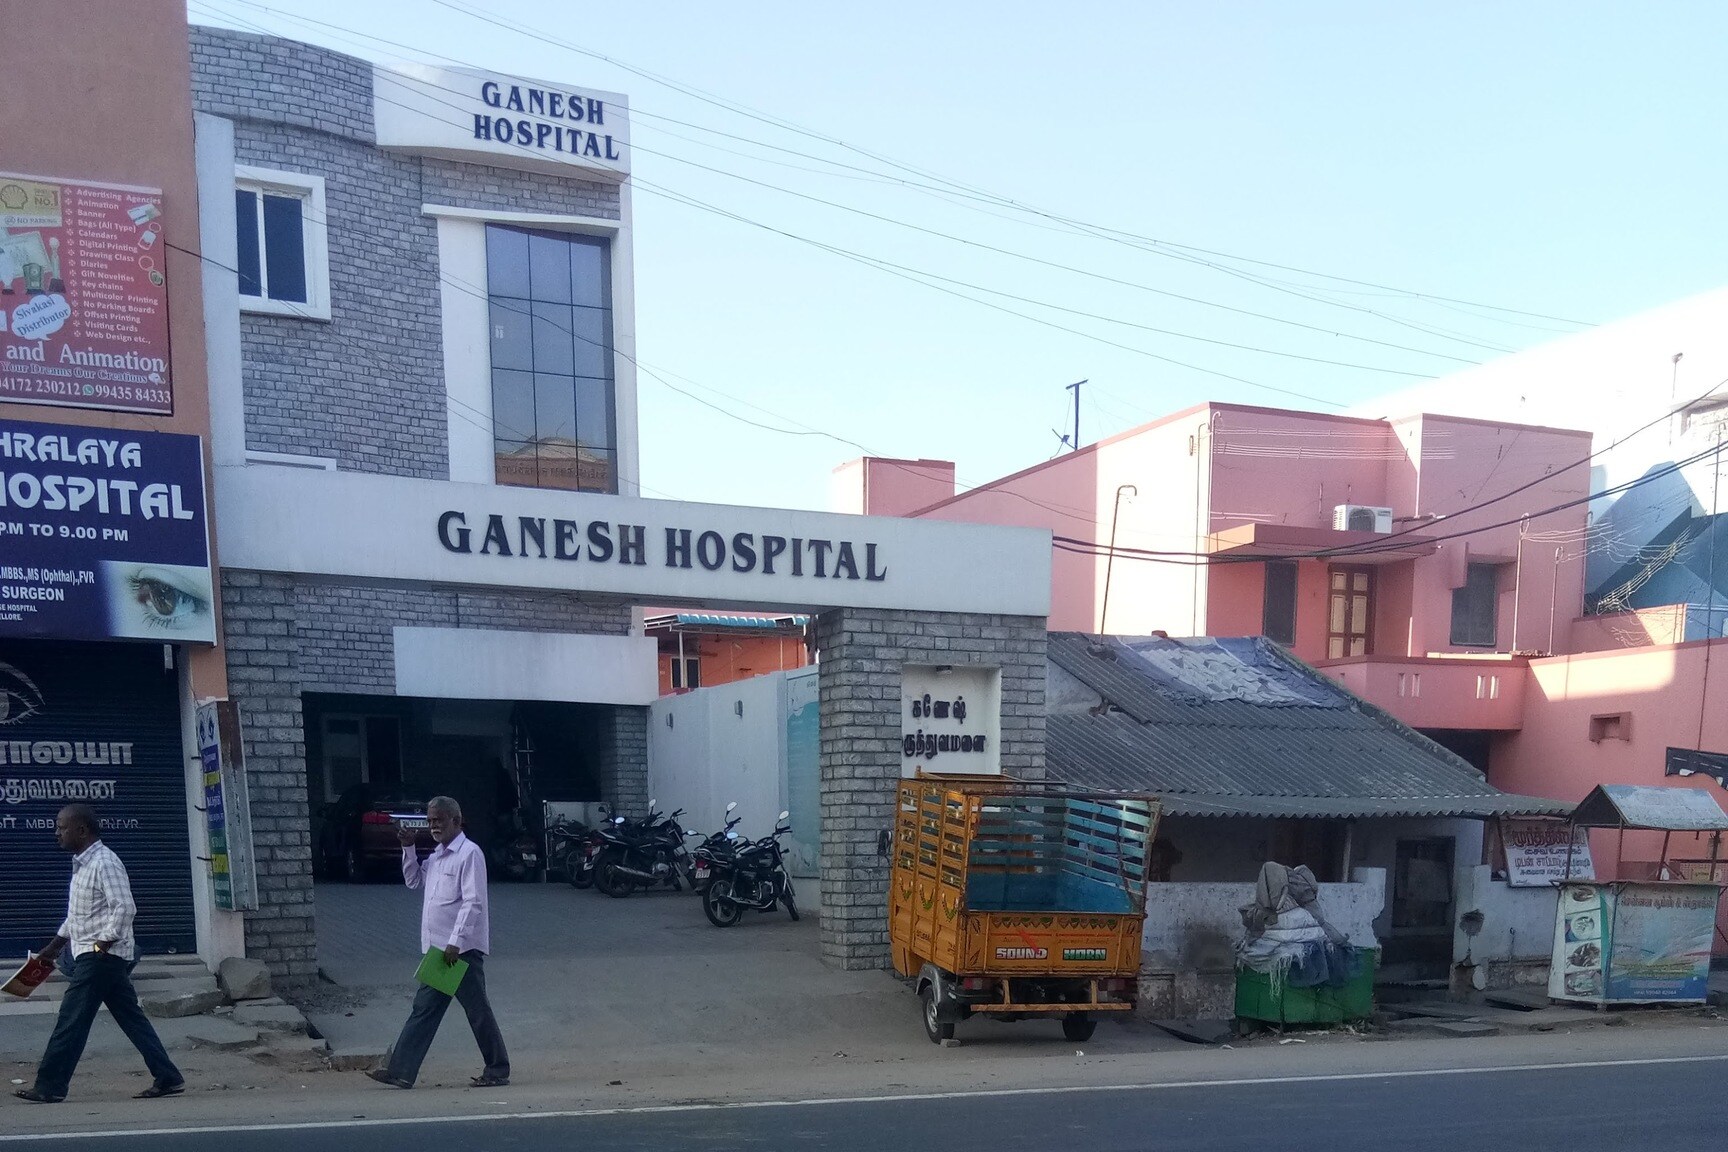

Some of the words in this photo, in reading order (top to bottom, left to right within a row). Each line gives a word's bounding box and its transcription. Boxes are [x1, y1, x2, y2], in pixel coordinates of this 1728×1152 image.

[481, 81, 604, 125] GANESH
[473, 114, 620, 160] HOSPITAL
[77, 189, 122, 201] Advertising
[126, 195, 161, 204] Agencies
[78, 200, 119, 210] Animation
[78, 209, 106, 218] Banner
[78, 220, 97, 228] Bags
[98, 221, 112, 230] (All
[115, 223, 136, 233] Type)
[79, 230, 117, 240] Calendars
[79, 240, 105, 249] Digital
[107, 243, 138, 253] Printing
[80, 250, 113, 260] Drawing
[115, 254, 134, 262] Class
[80, 261, 108, 269] Diaries
[98, 272, 134, 282] Novelties
[82, 281, 96, 289] Key
[98, 282, 123, 291] chains
[82, 291, 124, 301] Multicolor
[128, 295, 158, 305] Printing
[16, 296, 56, 319] Sivakasi
[97, 302, 126, 312] Parking
[128, 306, 155, 314] Boards
[17, 307, 69, 336] Distributor
[84, 311, 108, 319] Offset
[110, 314, 141, 324] Printing
[85, 321, 114, 331] Visiting
[116, 324, 138, 332] Cards
[86, 331, 104, 339] Web
[106, 333, 132, 342] Design
[6, 341, 45, 361] and
[59, 343, 167, 372] Animation
[0, 361, 29, 374] Your
[30, 363, 72, 377] Dreams
[73, 367, 96, 379] Our
[98, 369, 147, 384] Creations
[0, 377, 32, 392] 4172
[36, 380, 81, 396] 230212
[95, 385, 132, 400] 99435
[135, 389, 171, 404] 84333
[29, 524, 54, 537] TO
[59, 525, 97, 540] 9.00
[102, 528, 129, 542] PM
[437, 510, 647, 565] GANESH
[665, 527, 888, 582] HOSPITAL
[2, 586, 65, 601] SURGEON
[7, 604, 37, 612] HOSPITAL
[996, 947, 1048, 960] SOUND
[1063, 948, 1107, 961] HORN
